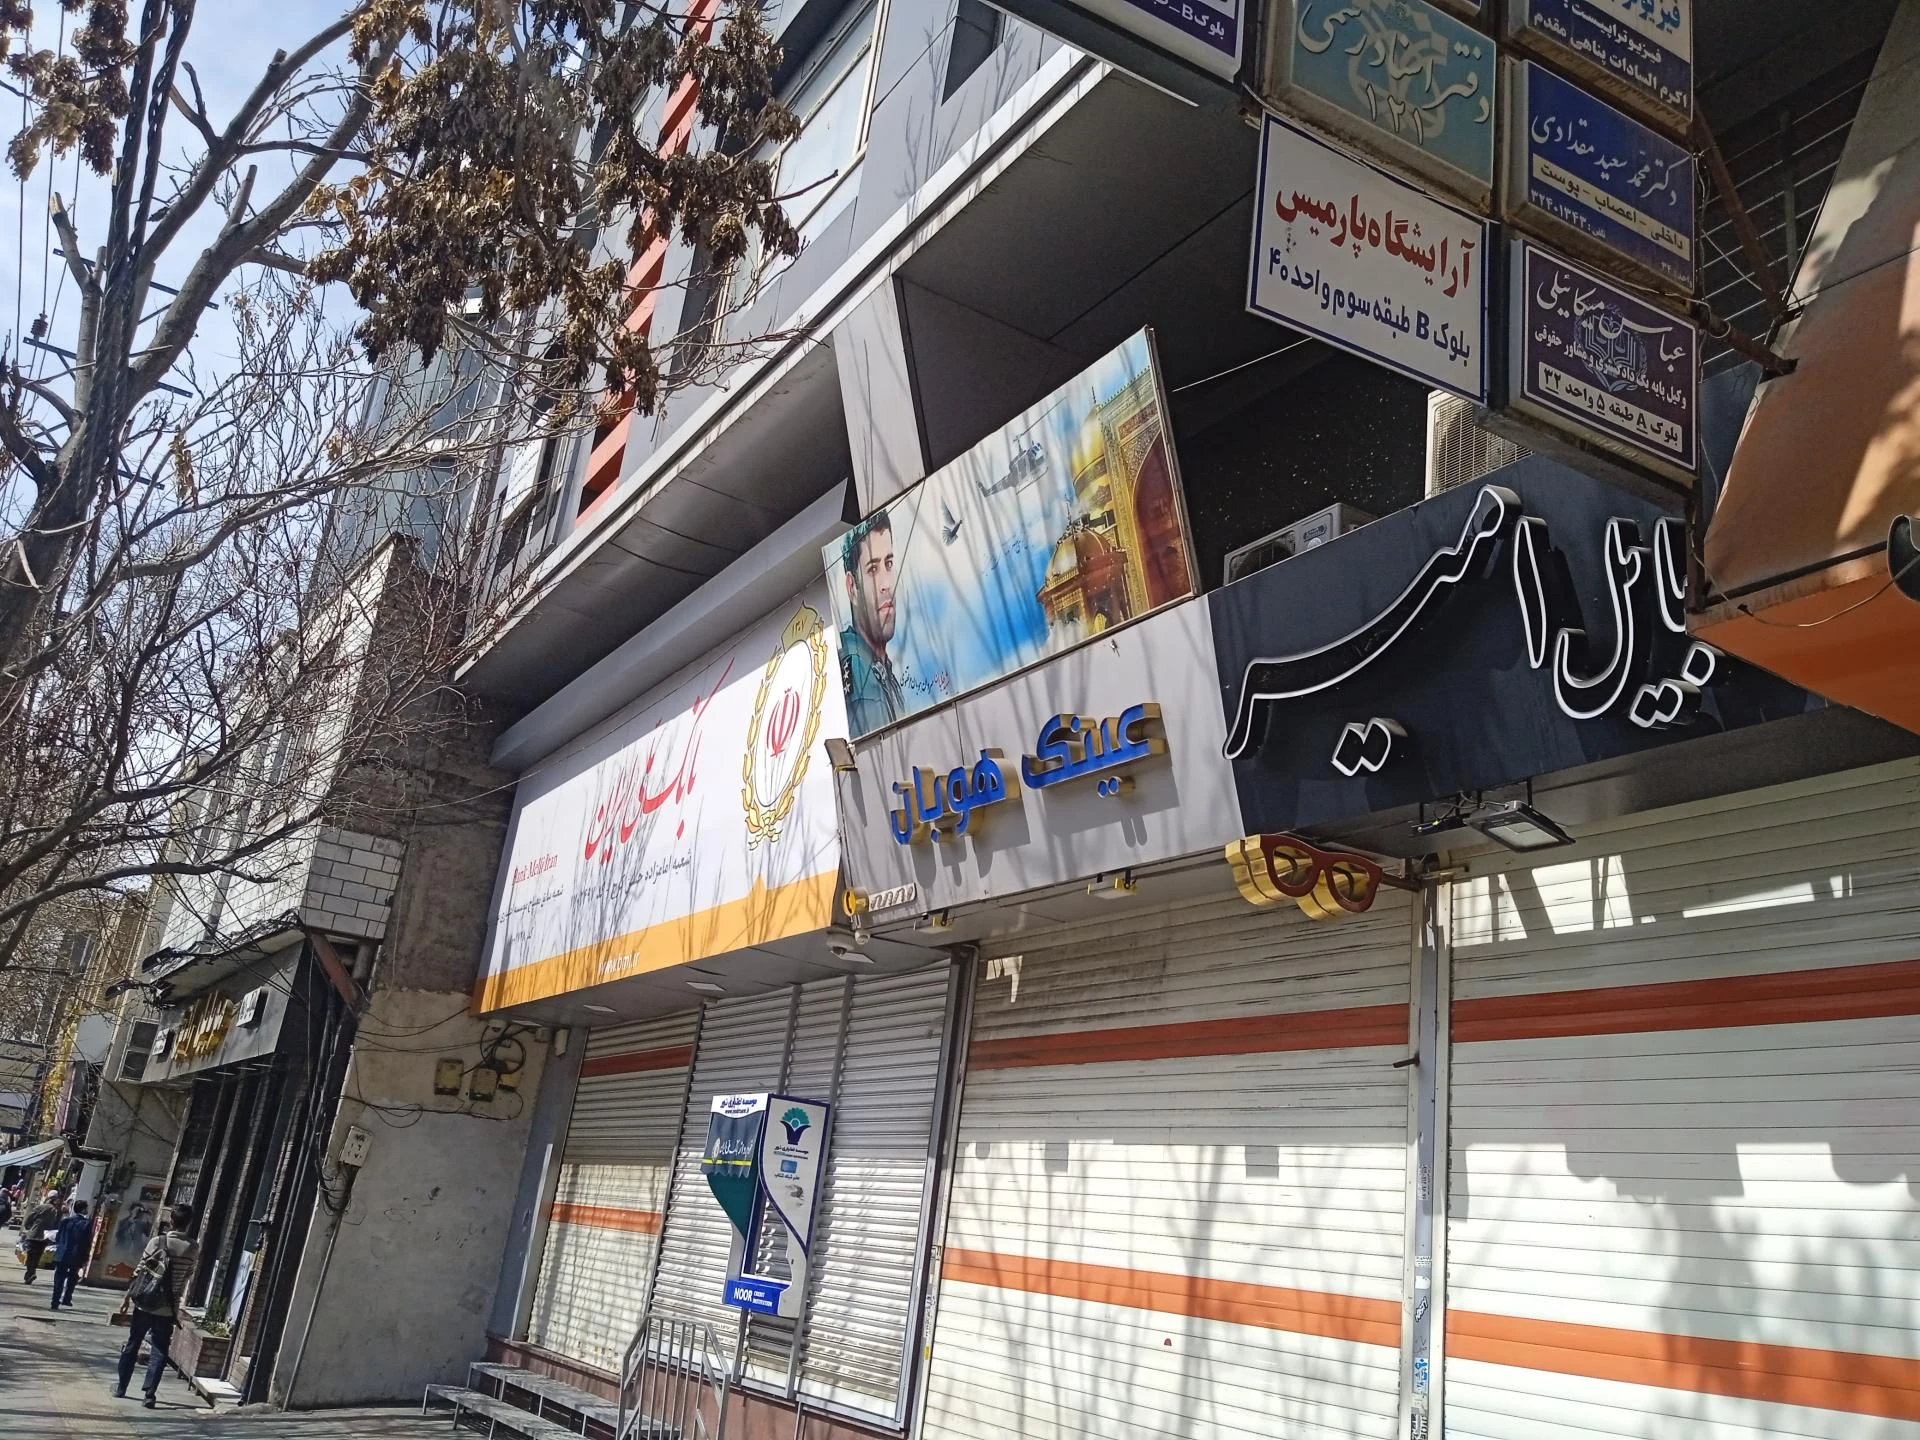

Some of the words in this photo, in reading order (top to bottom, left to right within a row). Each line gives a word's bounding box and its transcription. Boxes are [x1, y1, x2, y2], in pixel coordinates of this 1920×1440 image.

[1299, 3, 1367, 56] رسمی
[1533, 13, 1568, 38] مقدم
[1368, 33, 1434, 93] اسناد
[1570, 37, 1606, 65] پناهی
[1422, 41, 1490, 124] دفتر
[1609, 54, 1658, 89] السادات
[1660, 86, 1687, 108] اکرم
[1366, 83, 1424, 146] ۱۲۱
[1531, 115, 1595, 154] مقدادی
[1540, 164, 1580, 200] پوست
[1594, 154, 1628, 181] سعید
[1627, 151, 1651, 188] محمد
[1640, 155, 1692, 206] دکتر
[1275, 190, 1367, 259] پارمیس
[1594, 195, 1638, 223] اعصاب
[1368, 209, 1476, 298] آرایشگاه
[1650, 227, 1684, 251] داخلی
[1290, 264, 1330, 310] واحد
[1332, 288, 1370, 319] سوم
[1373, 296, 1410, 339] طبقه
[1415, 310, 1430, 341] B
[1534, 324, 1562, 348] حقوقی
[1433, 322, 1471, 367] بلوک
[1564, 343, 1588, 361] مشاور
[1599, 313, 1687, 373] عباس
[1543, 367, 1562, 390] ۳۲
[1636, 369, 1650, 393] یک
[1651, 379, 1666, 400] پایه
[1565, 383, 1594, 408] واحد
[1597, 394, 1605, 411] ۵
[1667, 385, 1687, 410] وکیل
[1608, 402, 1634, 423] طبقه
[1636, 412, 1648, 430] A
[1650, 422, 1678, 447] بلوک
[1222, 484, 1548, 777] امیر
[642, 657, 734, 840] بانک
[1021, 702, 1160, 798] عینک
[734, 1287, 753, 1302] NOOR
